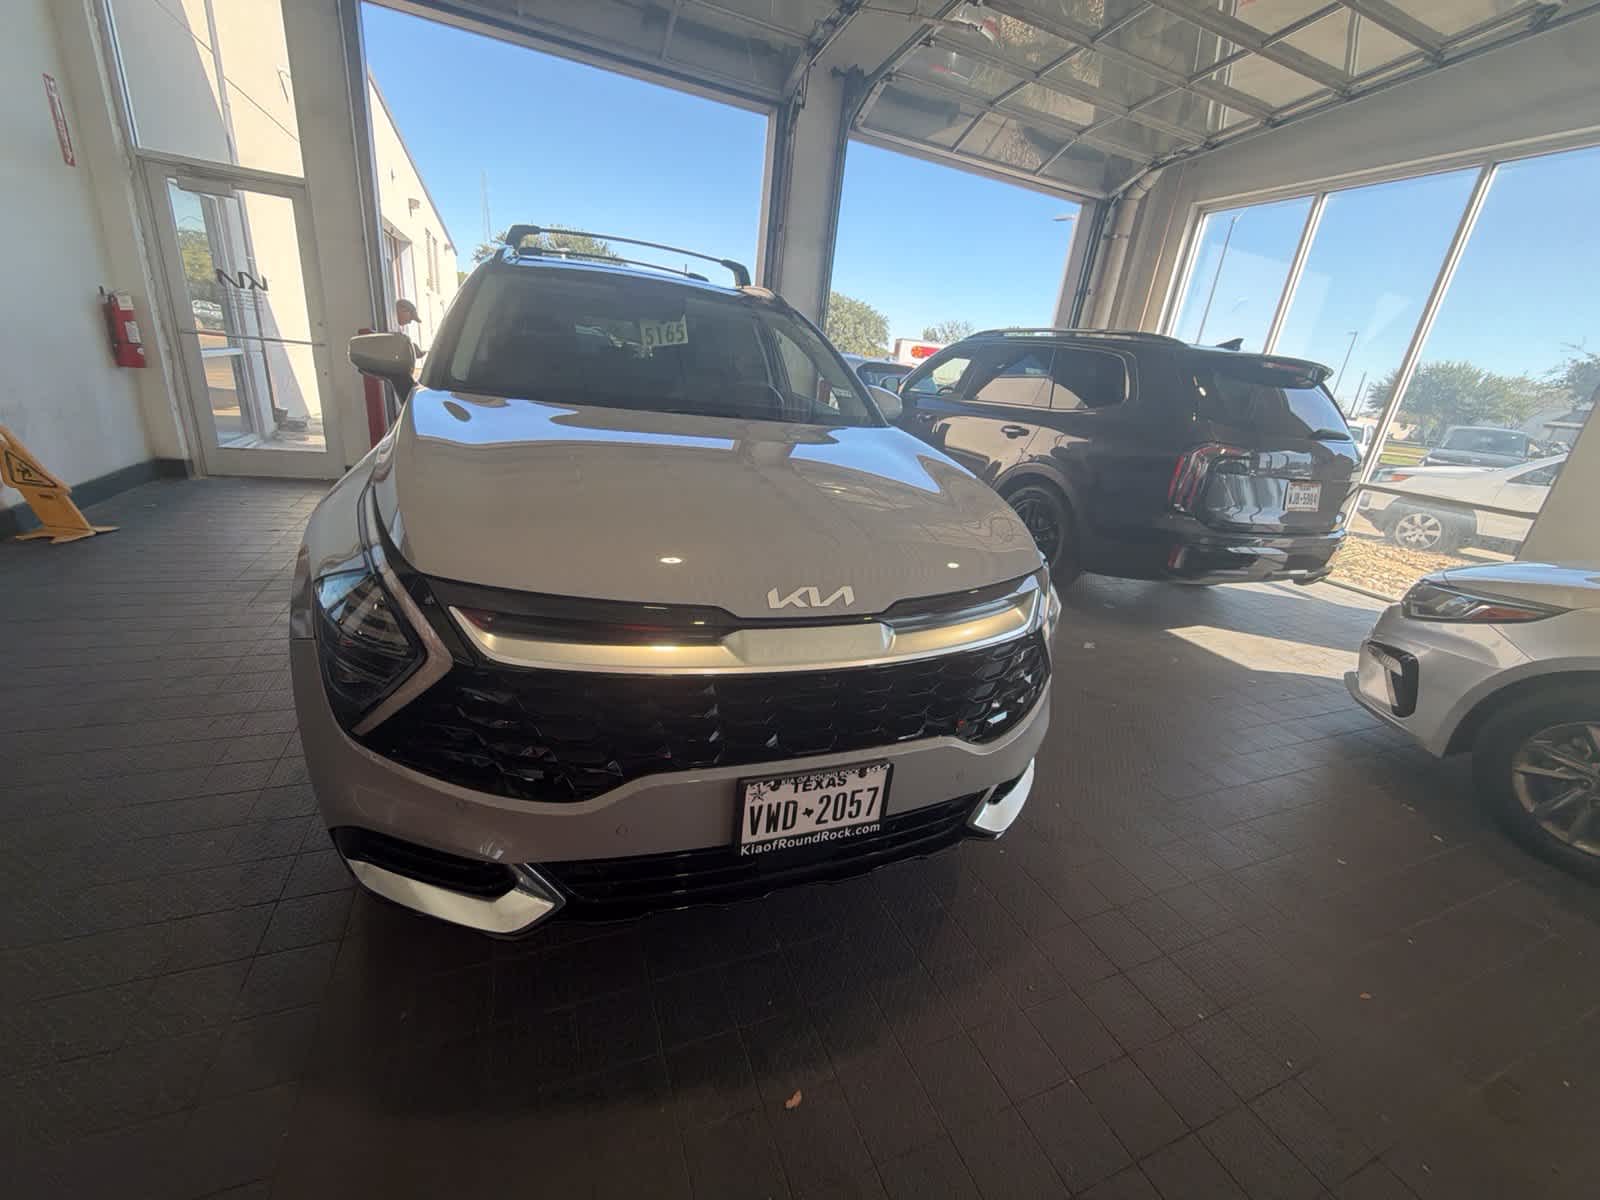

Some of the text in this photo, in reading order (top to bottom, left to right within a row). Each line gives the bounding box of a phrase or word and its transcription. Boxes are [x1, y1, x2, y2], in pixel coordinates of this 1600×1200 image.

[645, 322, 686, 344] 5165
[767, 586, 855, 608] KIA
[792, 776, 847, 793] TEXAS
[750, 787, 879, 836] VWD 2057
[740, 823, 880, 856] KiaofRoundRock.com
